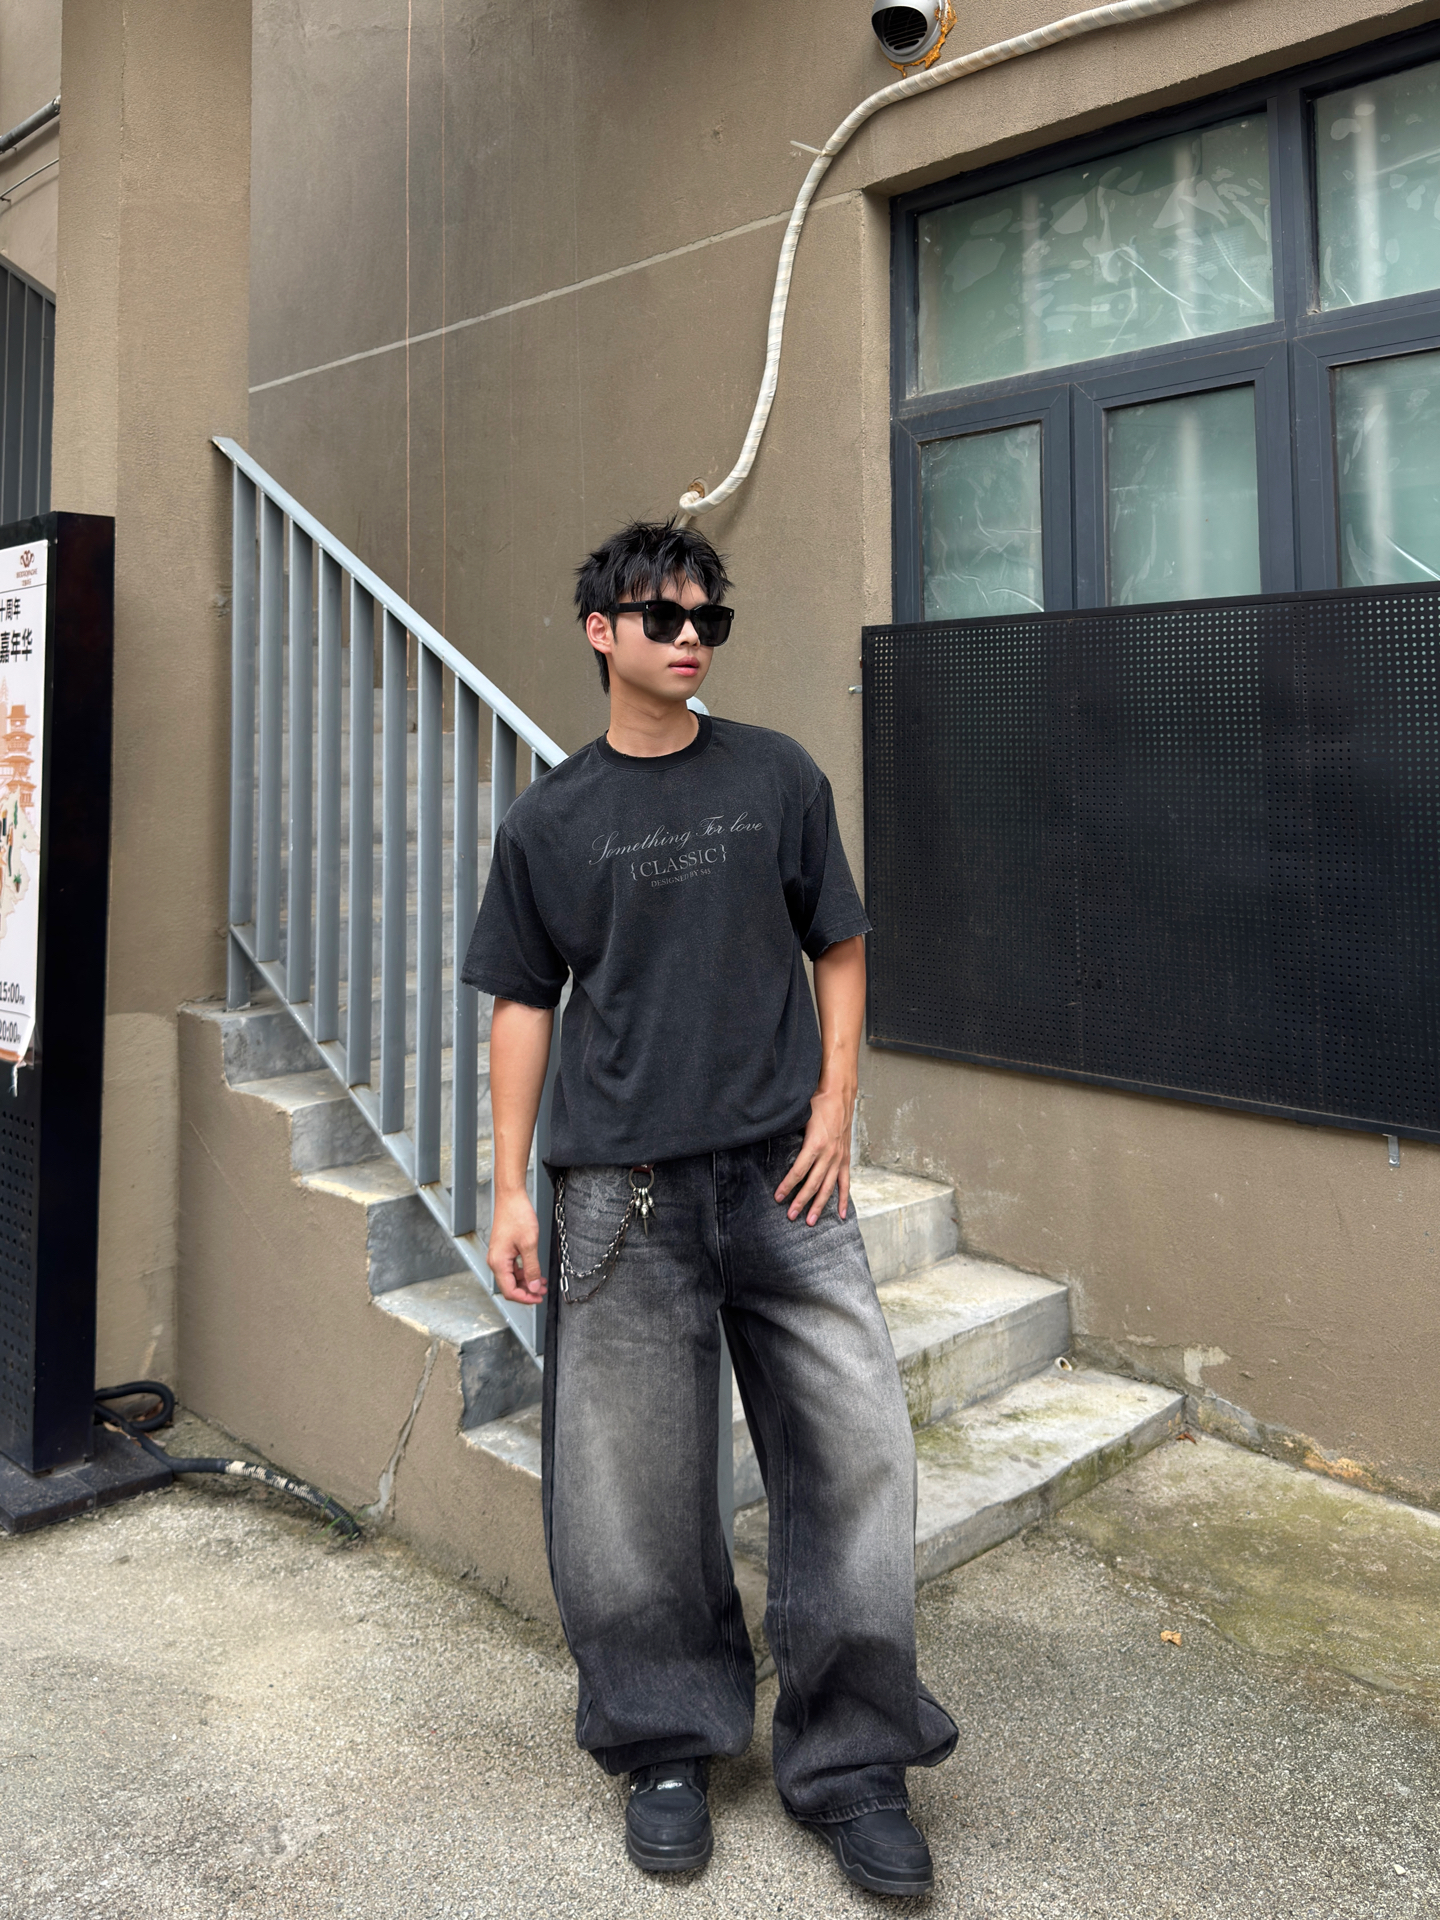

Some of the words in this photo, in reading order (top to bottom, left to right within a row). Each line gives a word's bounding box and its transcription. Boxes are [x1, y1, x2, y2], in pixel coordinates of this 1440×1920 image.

[0, 597, 21, 622] 十周年
[0, 628, 33, 663] 嘉年华
[589, 824, 692, 865] Something
[696, 815, 725, 837] For
[730, 811, 764, 833] love
[651, 872, 689, 888] DESIGNED
[689, 869, 699, 879] BY
